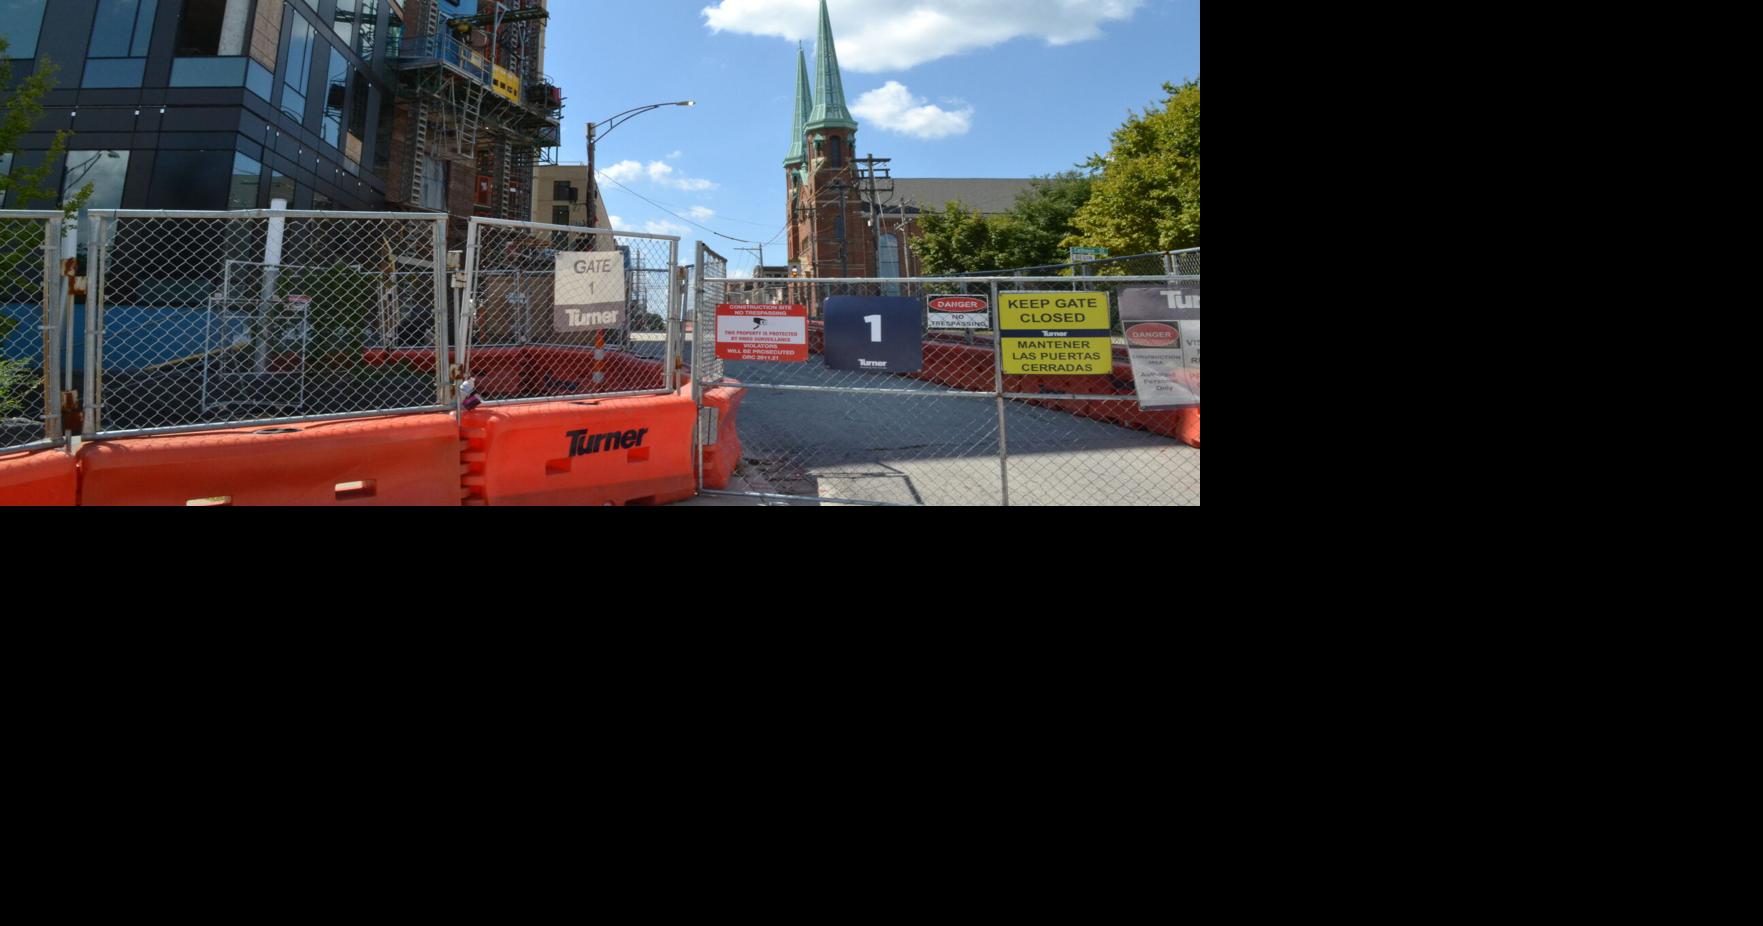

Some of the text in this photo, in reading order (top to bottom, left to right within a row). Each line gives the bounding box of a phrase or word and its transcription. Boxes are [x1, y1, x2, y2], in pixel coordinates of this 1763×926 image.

[574, 258, 611, 274] GATE
[588, 282, 594, 295] 1
[1008, 298, 1097, 309] KEEP GATE
[565, 308, 620, 326] Turner
[1020, 313, 1086, 323] CLOSED
[864, 314, 882, 342] 1
[858, 358, 887, 367] Turner
[1040, 352, 1101, 360] PUERTAS
[566, 427, 648, 457] Turner
